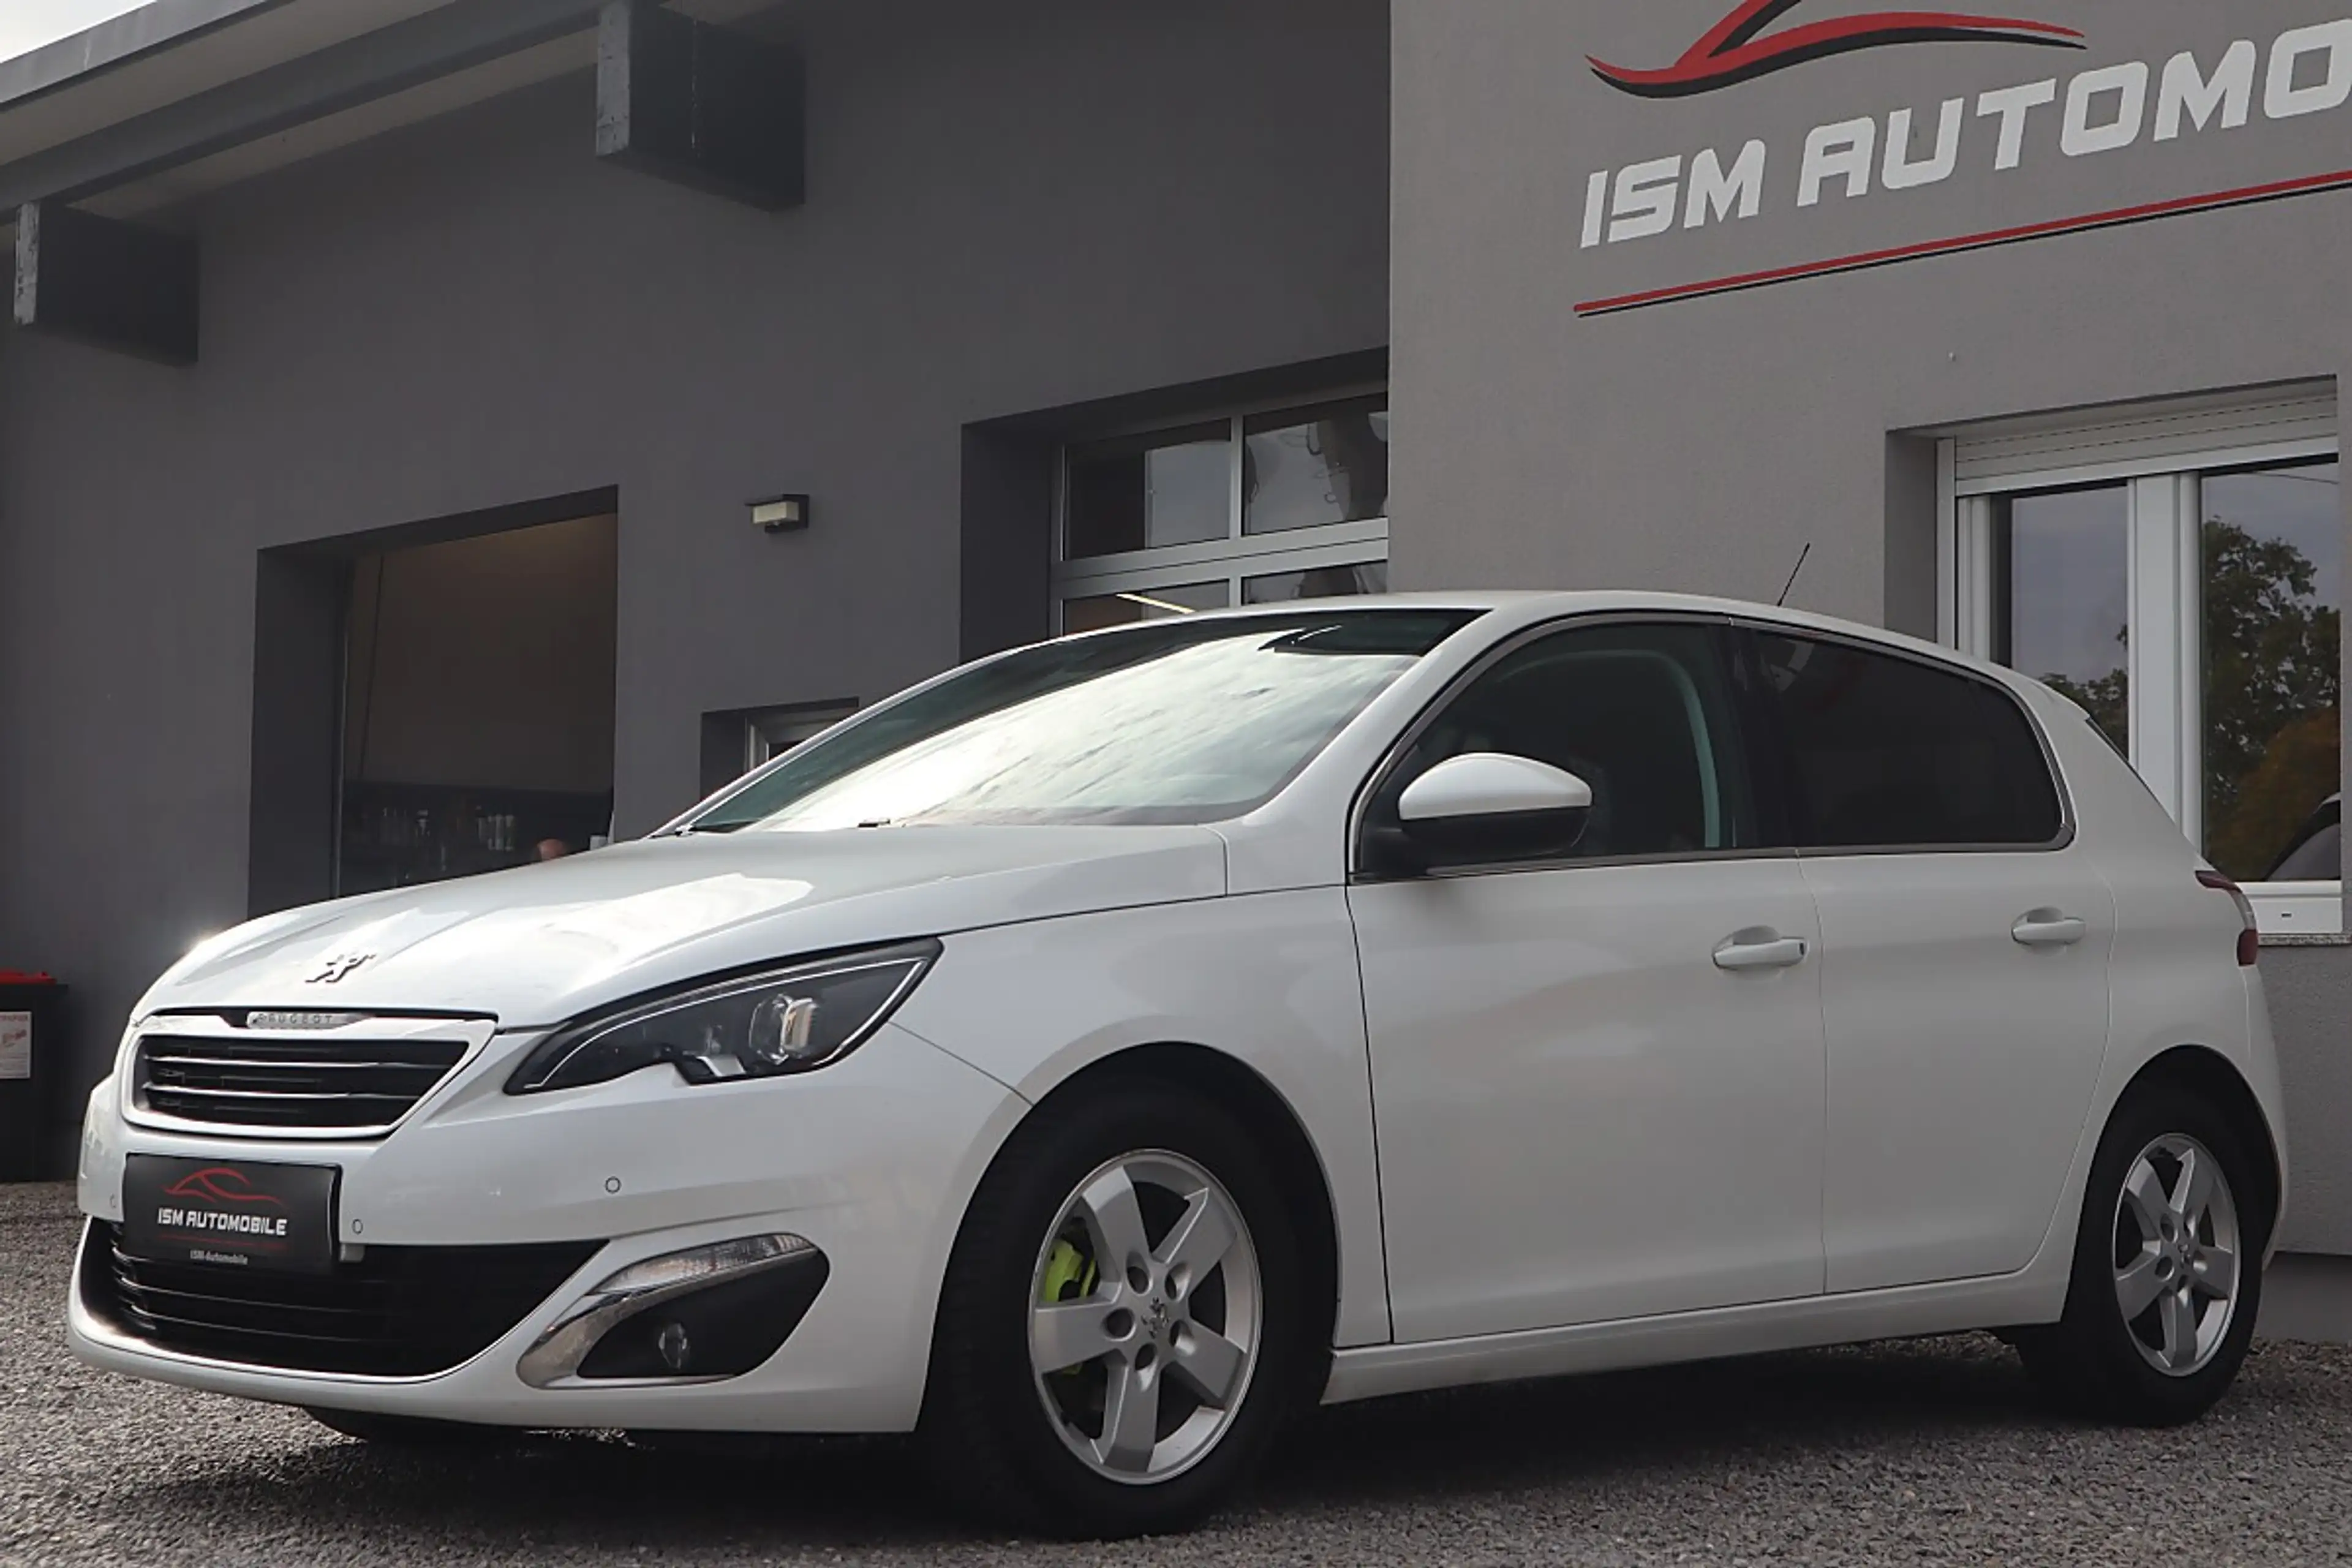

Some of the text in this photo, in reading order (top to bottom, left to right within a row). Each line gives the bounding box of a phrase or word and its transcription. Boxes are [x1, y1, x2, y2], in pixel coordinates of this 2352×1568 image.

[1580, 19, 2352, 248] ISM AUTOMO
[157, 1208, 287, 1235] ISM AUTOMOBILE
